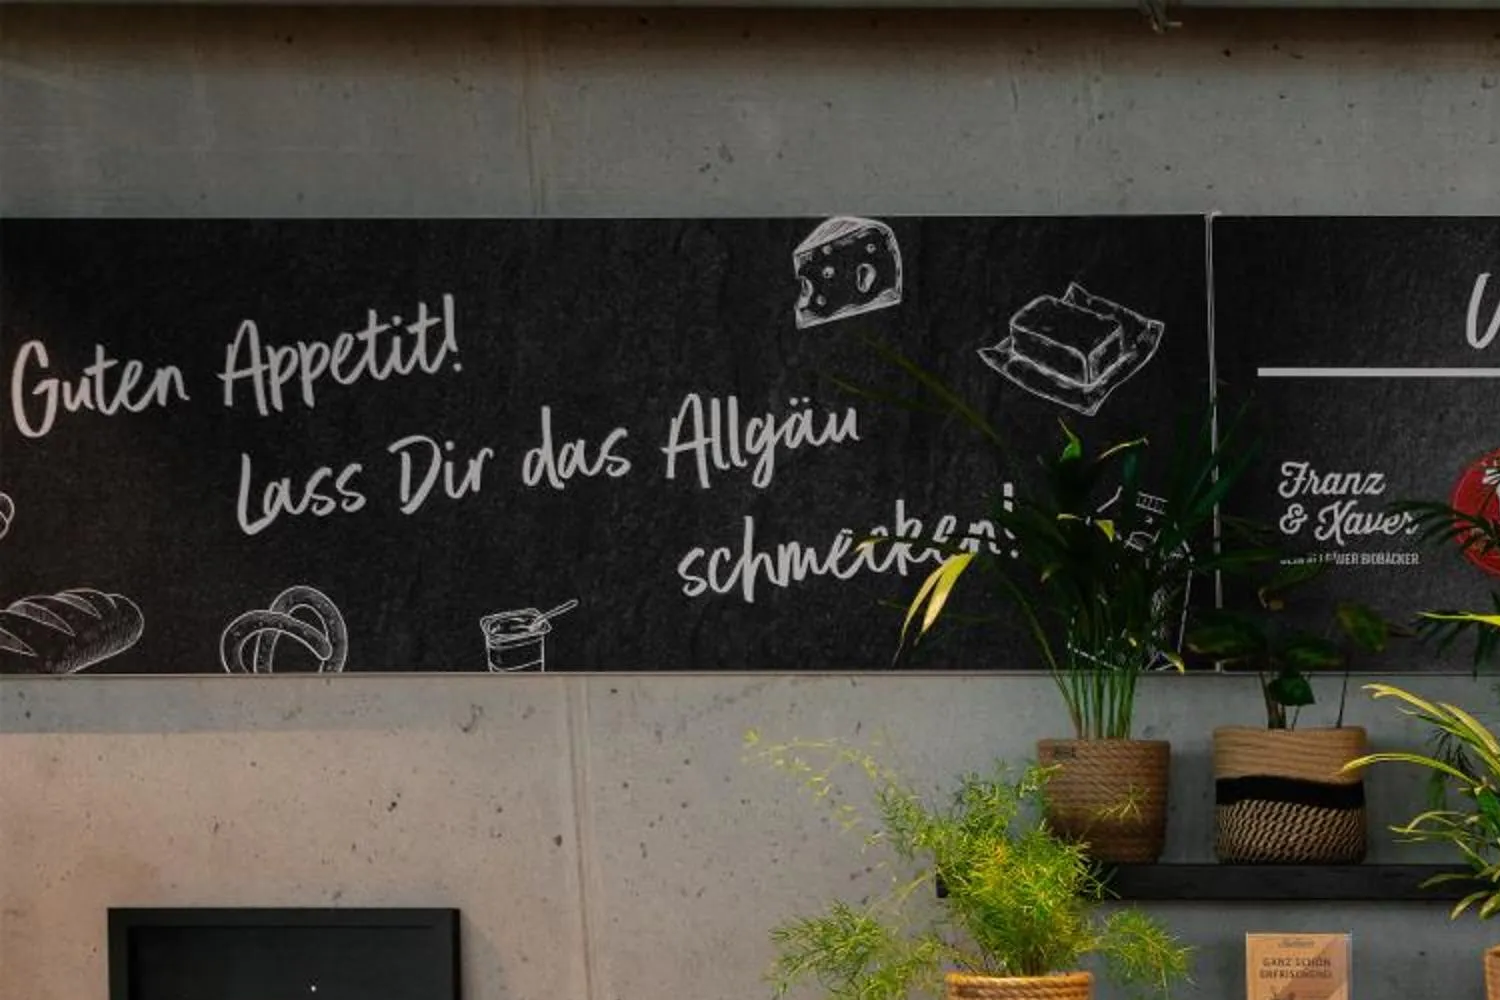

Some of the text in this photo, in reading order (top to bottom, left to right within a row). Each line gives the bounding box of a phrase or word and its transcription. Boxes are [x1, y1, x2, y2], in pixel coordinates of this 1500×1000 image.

[11, 293, 462, 438] Guten Appetit!
[237, 392, 860, 535] Lass Dir das Allgäu
[1278, 461, 1387, 499] Franz
[1279, 499, 1420, 547] & Xaver
